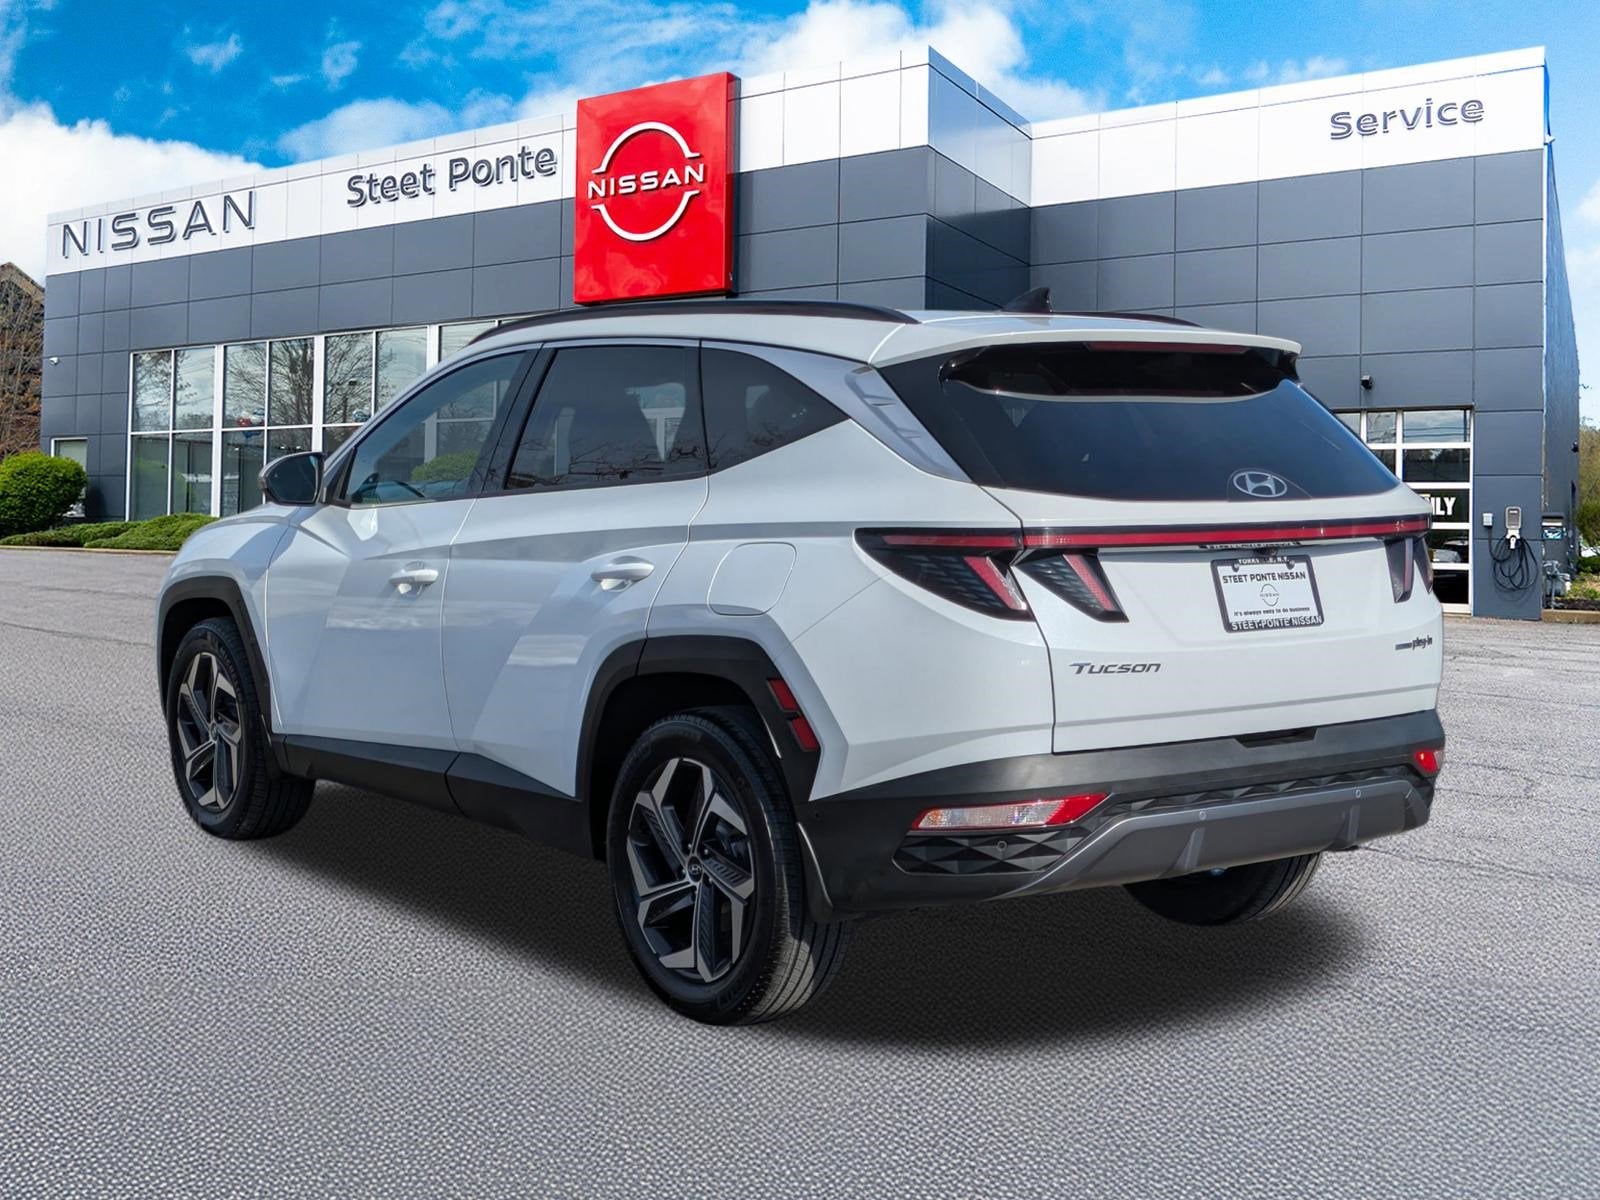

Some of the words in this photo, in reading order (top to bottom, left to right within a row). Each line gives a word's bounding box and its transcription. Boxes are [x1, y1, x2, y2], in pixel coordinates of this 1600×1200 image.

[1330, 98, 1484, 140] Service
[347, 163, 436, 207] Steet
[449, 146, 557, 191] Ponte
[588, 163, 704, 199] NISSAN
[62, 191, 255, 259] NISSAN
[1222, 574, 1248, 583] STEET
[1249, 572, 1277, 582] PONTE
[1277, 571, 1306, 580] NISSAN
[1291, 615, 1322, 626] NISSAN
